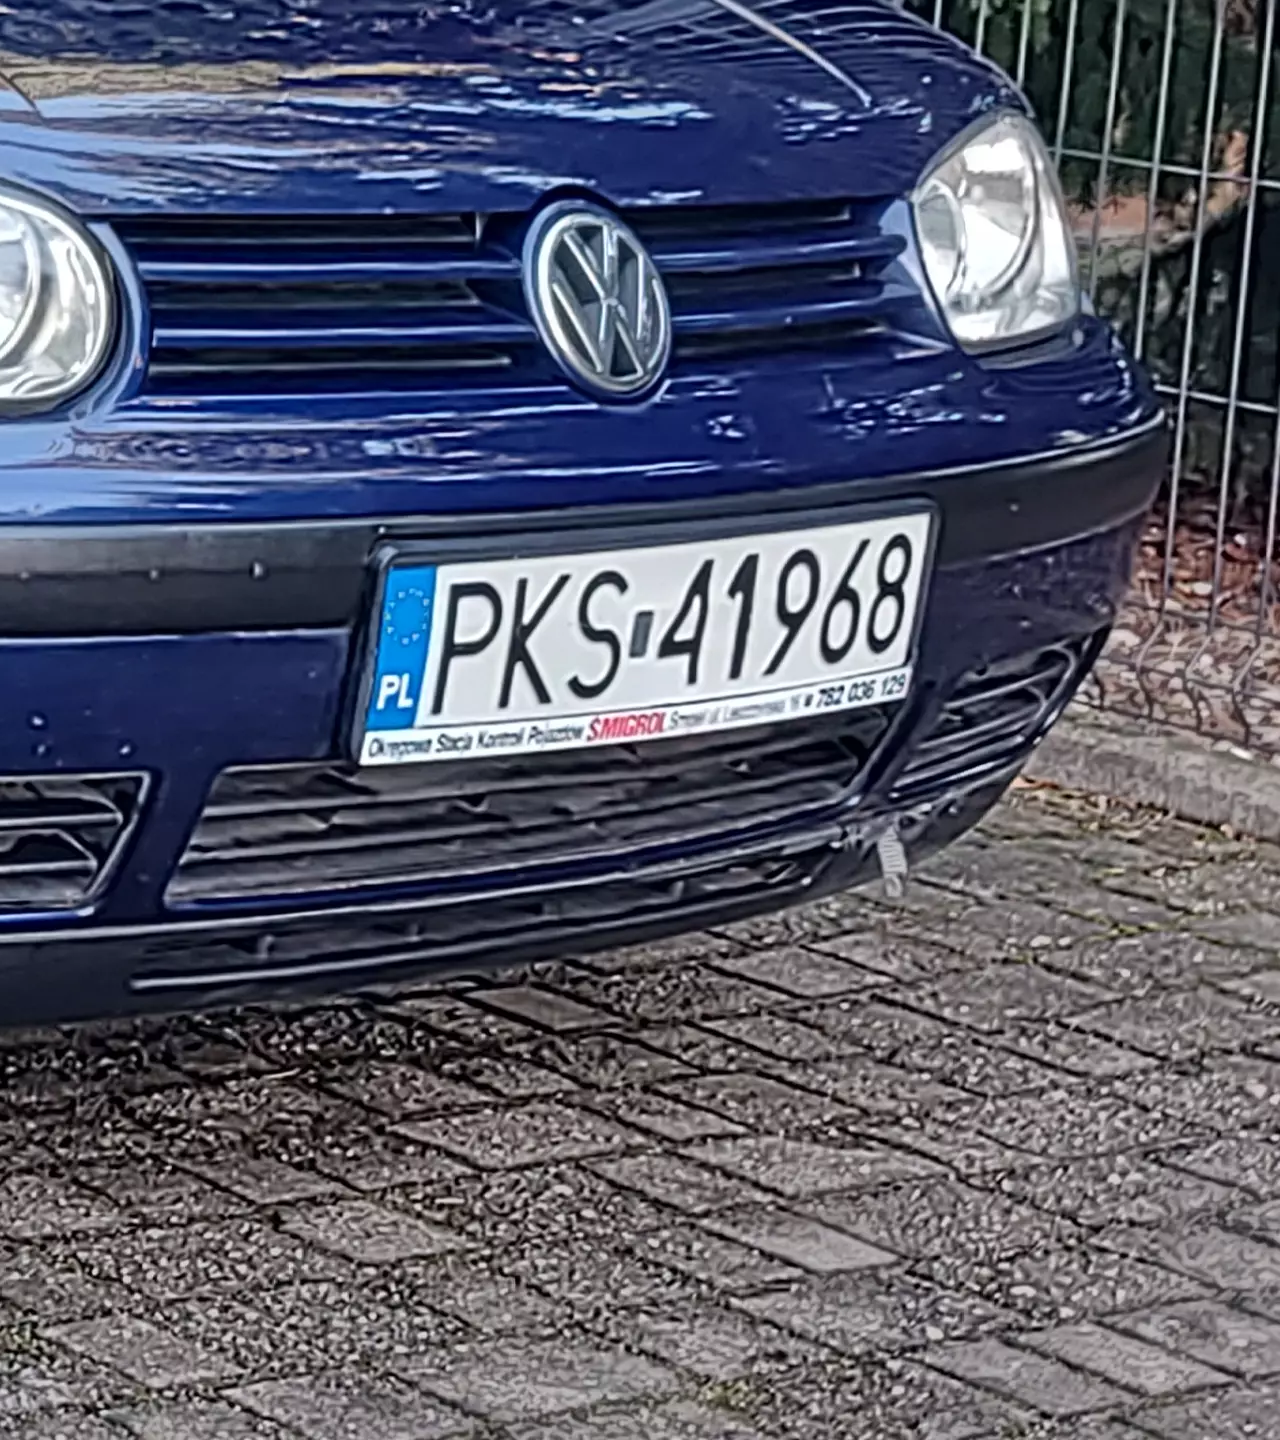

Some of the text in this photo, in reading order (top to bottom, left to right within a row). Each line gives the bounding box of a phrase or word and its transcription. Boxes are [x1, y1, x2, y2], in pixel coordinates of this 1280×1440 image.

[430, 532, 913, 715] PKS 41968
[376, 672, 414, 710] PL
